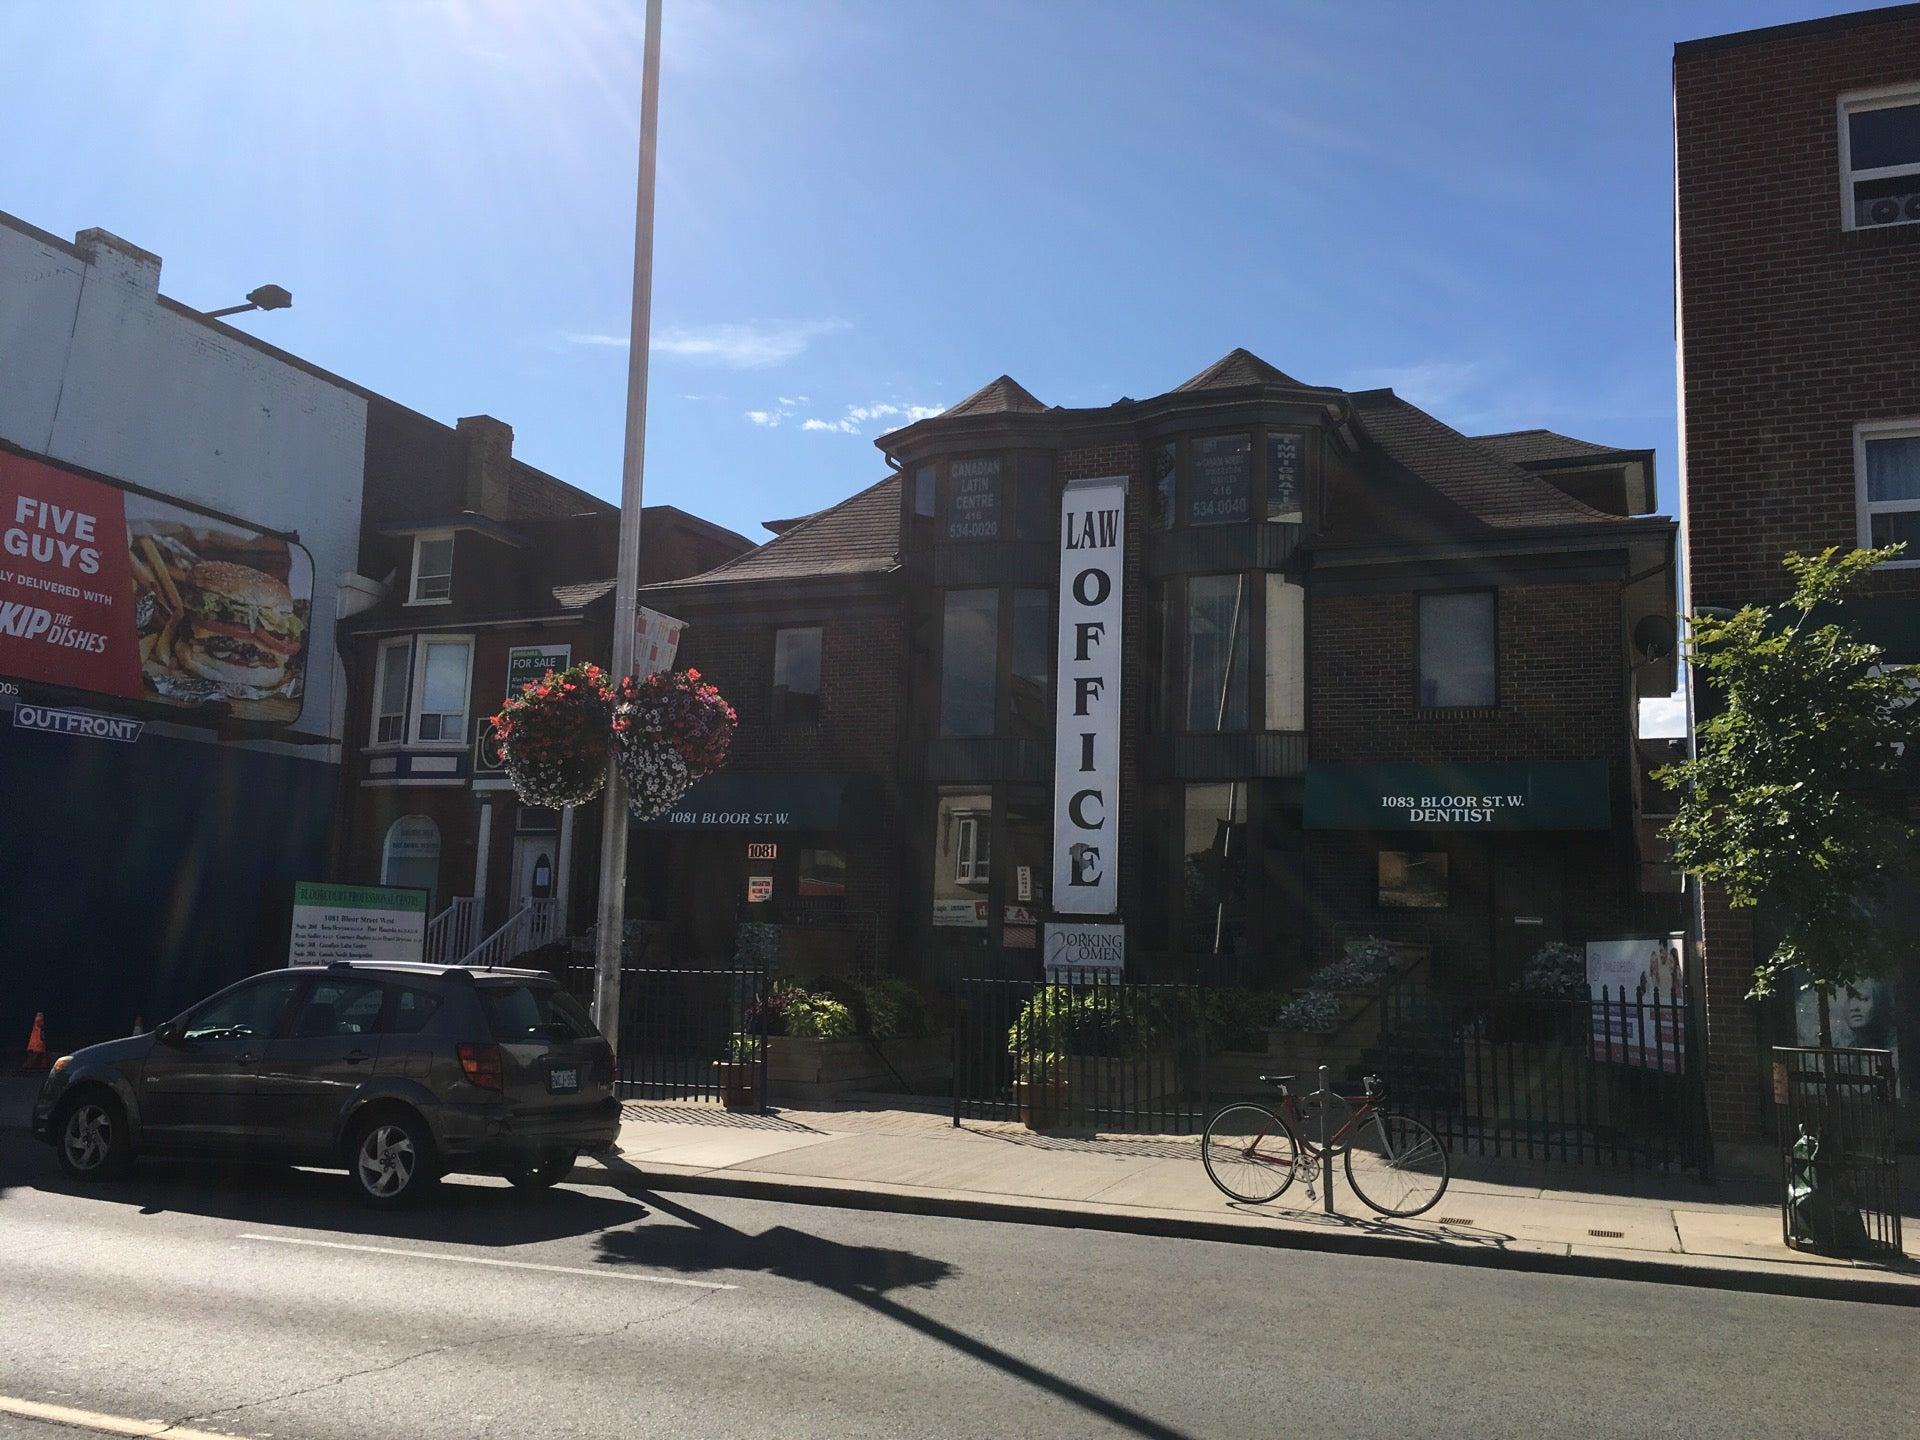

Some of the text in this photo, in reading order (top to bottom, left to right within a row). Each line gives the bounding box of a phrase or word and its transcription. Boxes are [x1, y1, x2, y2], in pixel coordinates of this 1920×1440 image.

[951, 460, 1001, 478] CANADIAN
[961, 477, 989, 493] LATIN
[1213, 486, 1232, 496] 416
[956, 493, 994, 510] CENTRE
[15, 495, 97, 542] FIVE
[964, 511, 982, 521] 416
[1066, 510, 1119, 550] LAW
[4, 528, 101, 574] GUYS
[0, 570, 112, 605] LY DELIVERED WITH
[0, 600, 73, 640] KIP THE
[47, 625, 108, 653] DISHES
[513, 657, 556, 669] FOR SALE
[19, 707, 138, 740] OUTFRONT
[1068, 568, 1111, 886] OFFICE
[1381, 795, 1525, 808] 1083 BLOOR ST. W.
[669, 812, 790, 825] 1081 BLOOR ST. W.
[1410, 808, 1495, 823] DENTIST
[749, 844, 775, 858] 1081
